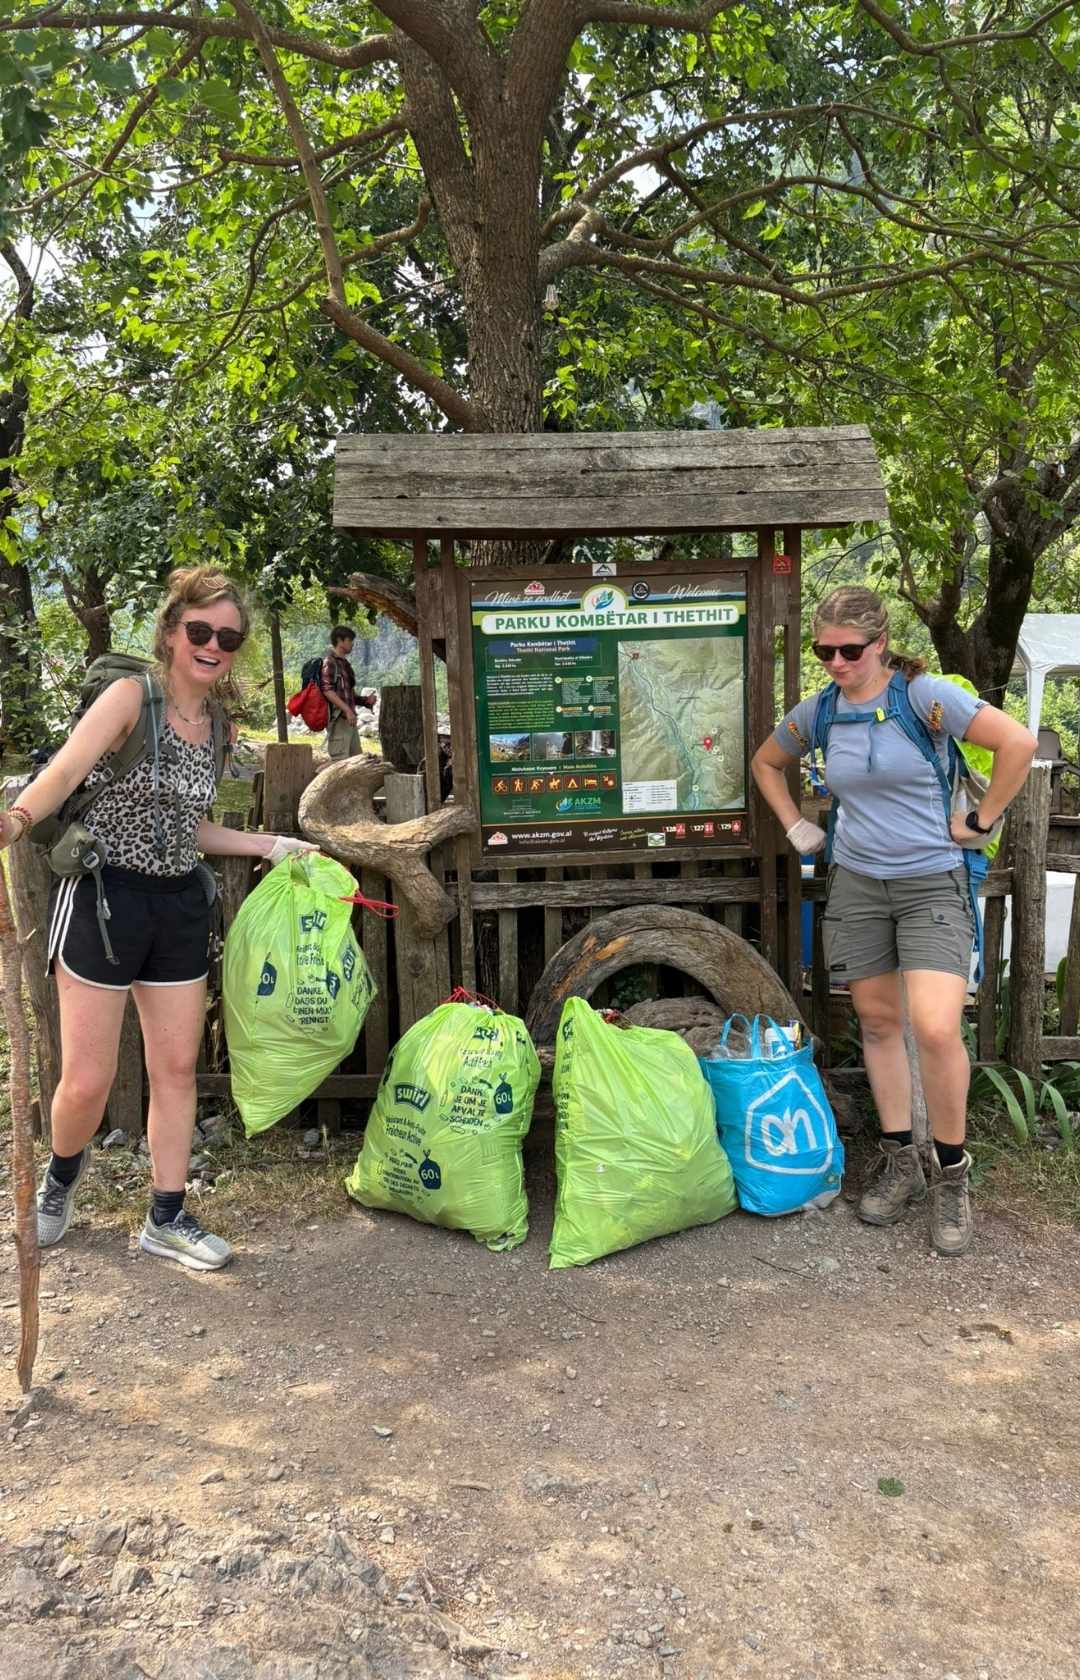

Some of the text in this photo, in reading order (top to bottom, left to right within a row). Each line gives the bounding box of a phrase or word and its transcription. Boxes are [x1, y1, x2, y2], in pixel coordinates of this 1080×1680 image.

[495, 608, 734, 630] PARKU KOMBËTAR I THETHIT
[575, 797, 601, 806] AKZM
[511, 831, 573, 840] www.akzm.gov.al
[397, 1087, 429, 1108] swirl
